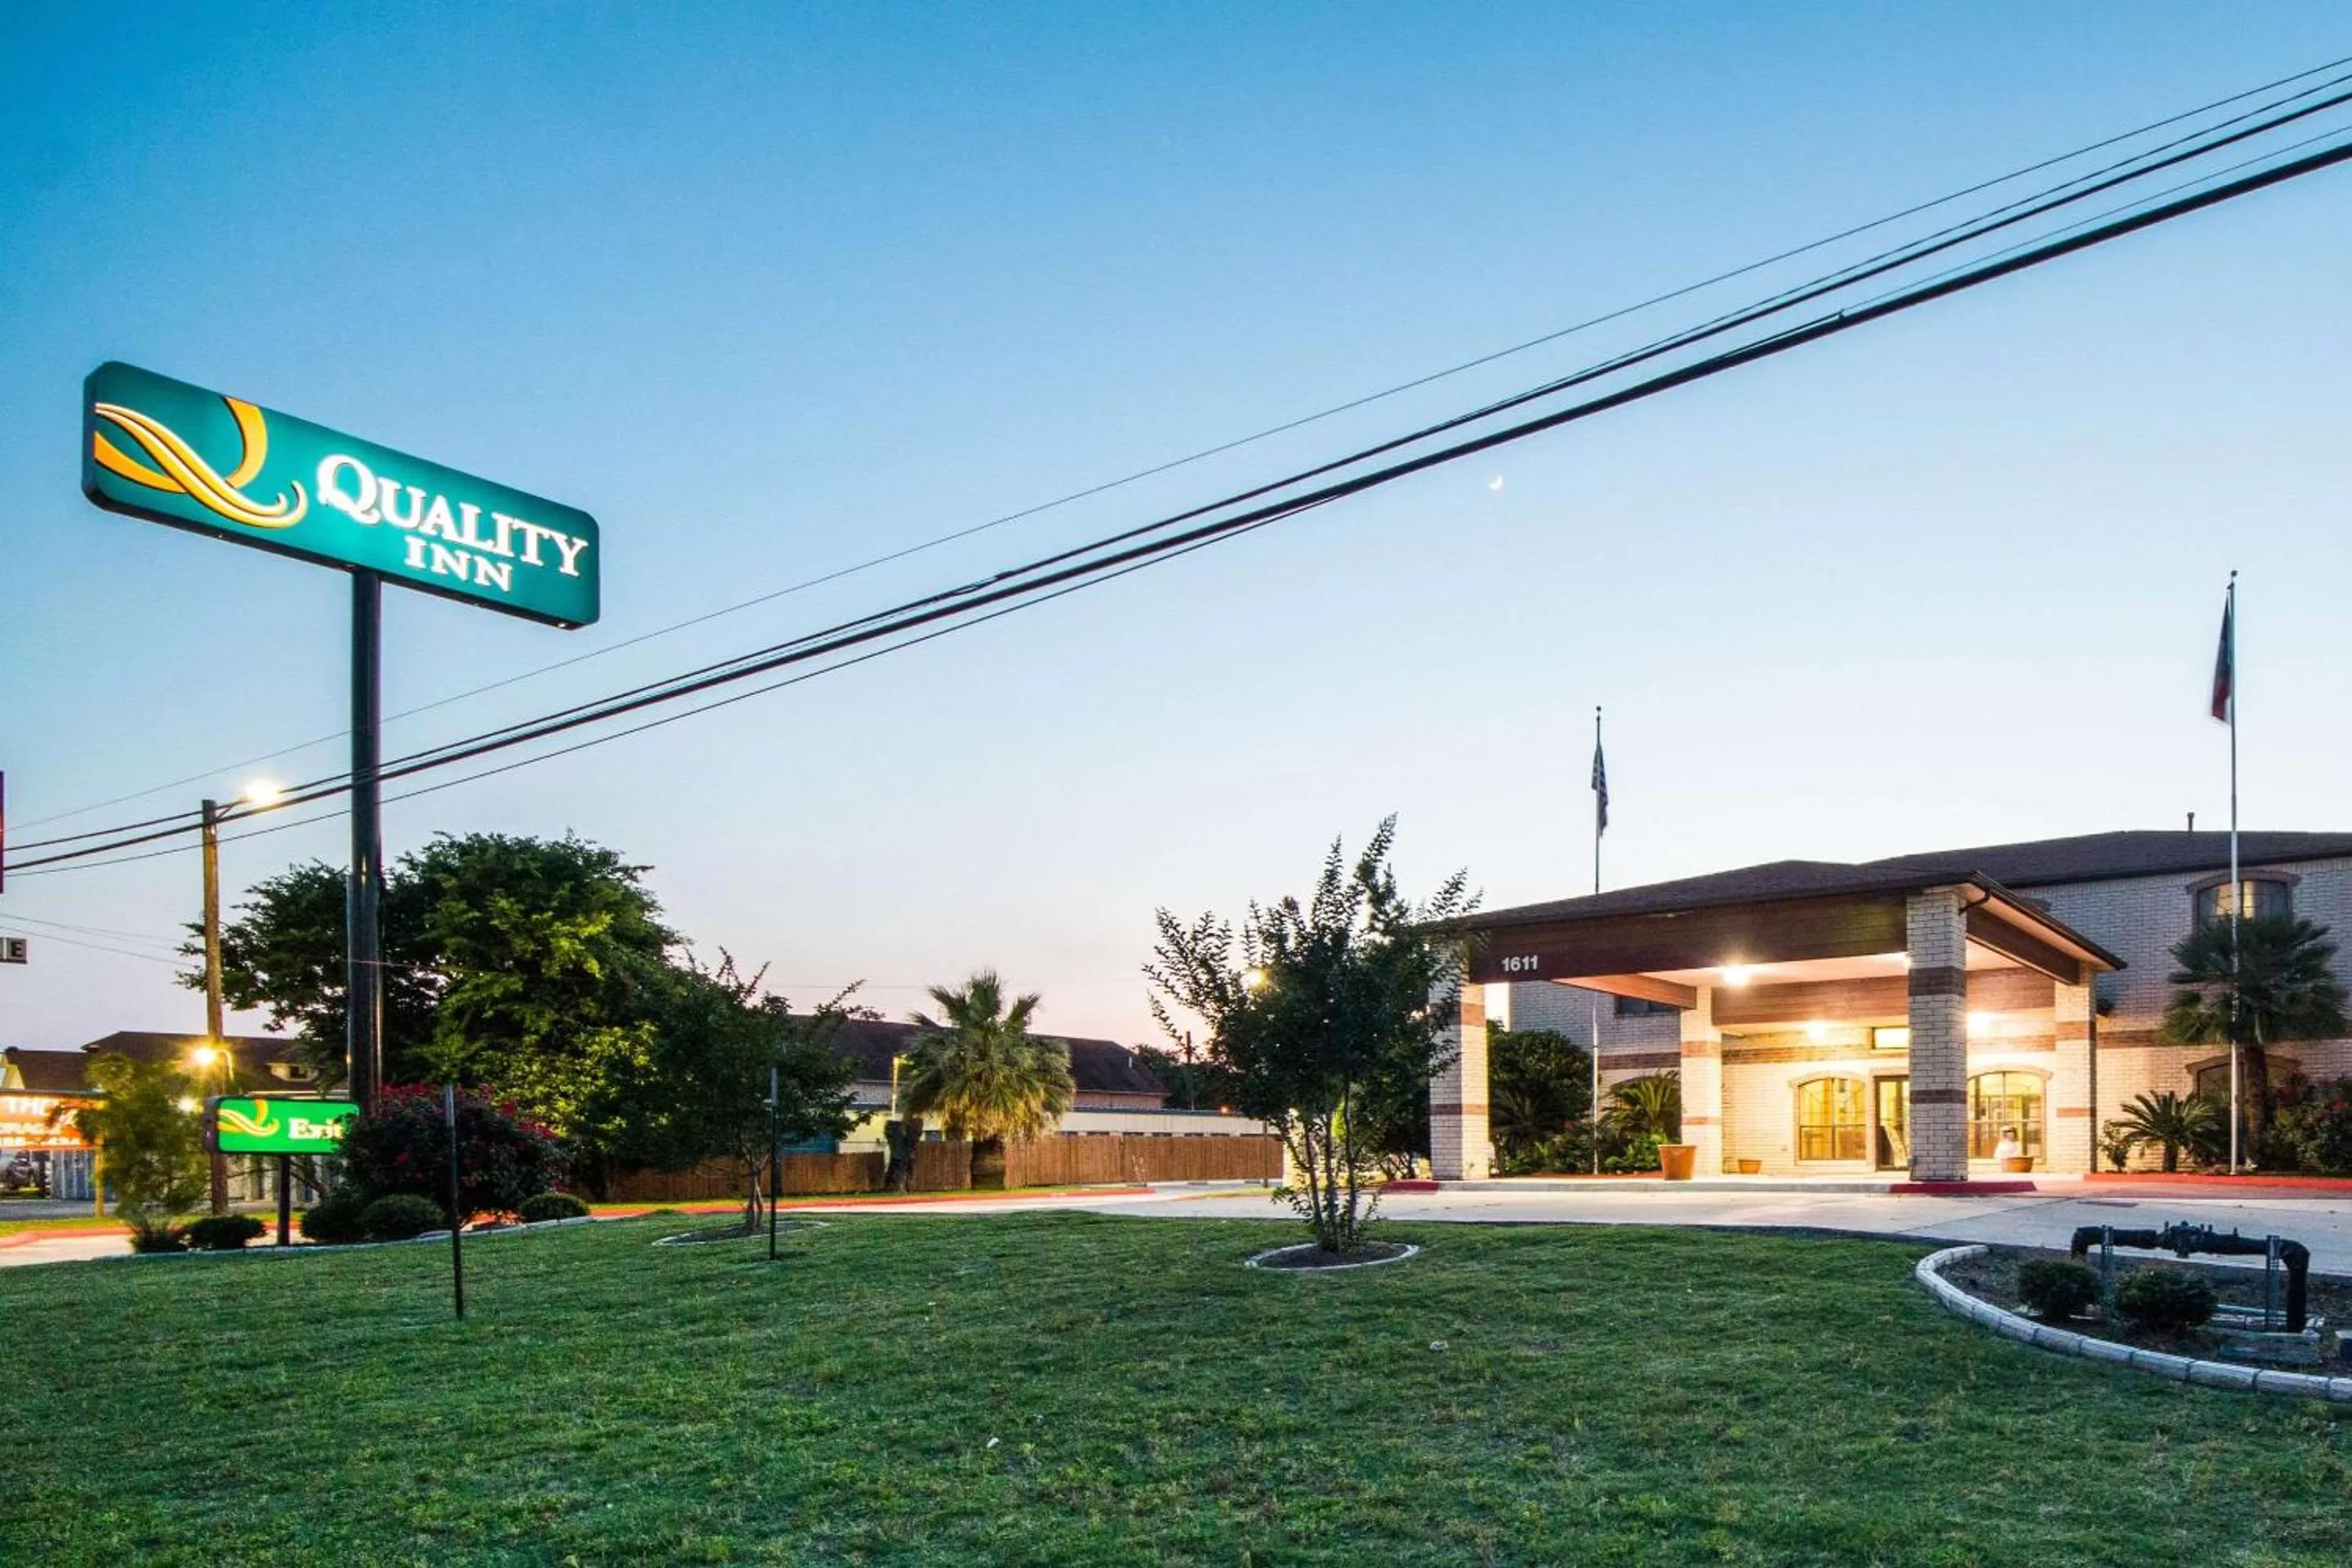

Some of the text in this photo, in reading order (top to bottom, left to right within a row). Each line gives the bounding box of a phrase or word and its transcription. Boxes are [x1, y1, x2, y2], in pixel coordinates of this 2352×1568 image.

[317, 454, 589, 577] QUALITY
[405, 535, 513, 591] INN
[1501, 955, 1539, 972] 1611
